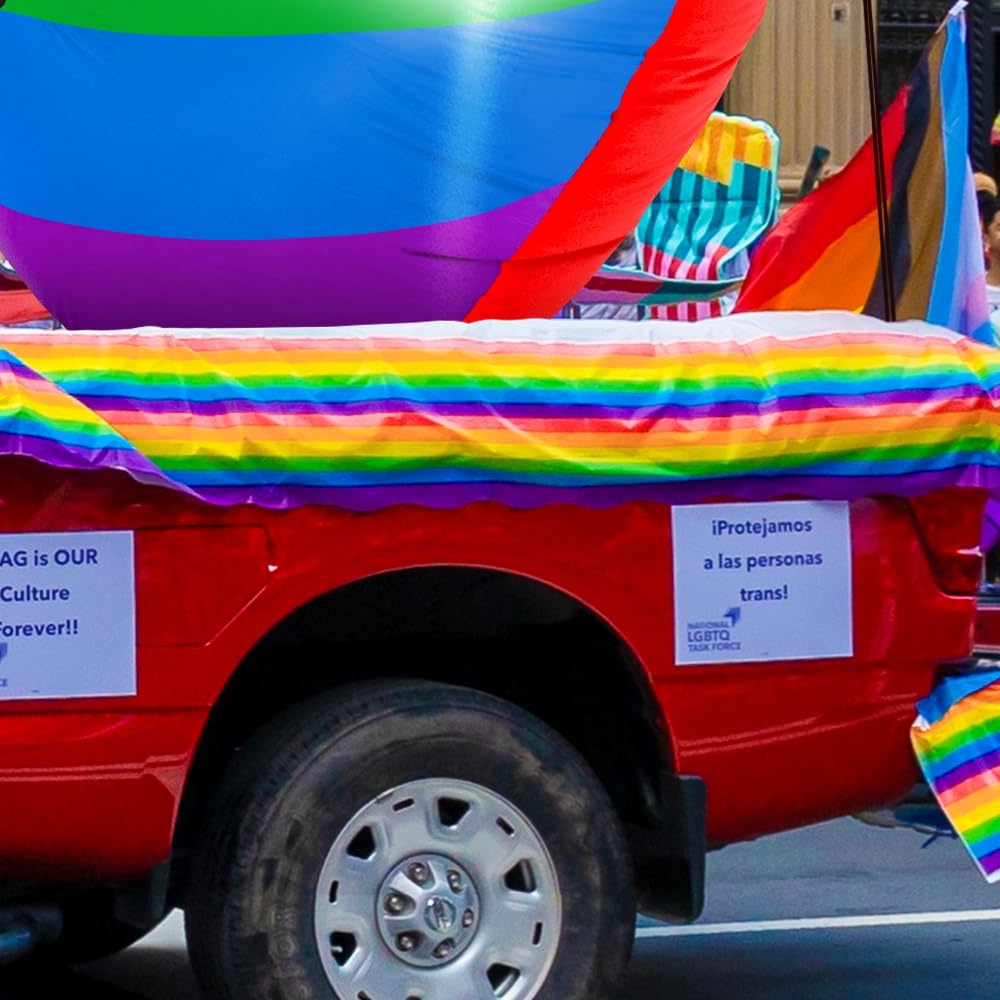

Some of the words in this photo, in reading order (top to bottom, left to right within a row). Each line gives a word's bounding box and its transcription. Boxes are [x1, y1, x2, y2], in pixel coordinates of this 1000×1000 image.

[712, 518, 813, 538] ¡Protejamos
[33, 549, 49, 566] is
[53, 548, 98, 566] OUR
[703, 558, 713, 570] a
[718, 553, 742, 569] las
[746, 552, 823, 572] personas
[0, 585, 70, 602] Culture
[740, 584, 788, 602] trans!
[687, 630, 730, 643] LGBTQ
[688, 643, 711, 652] TASK
[711, 642, 741, 651] FORCE
